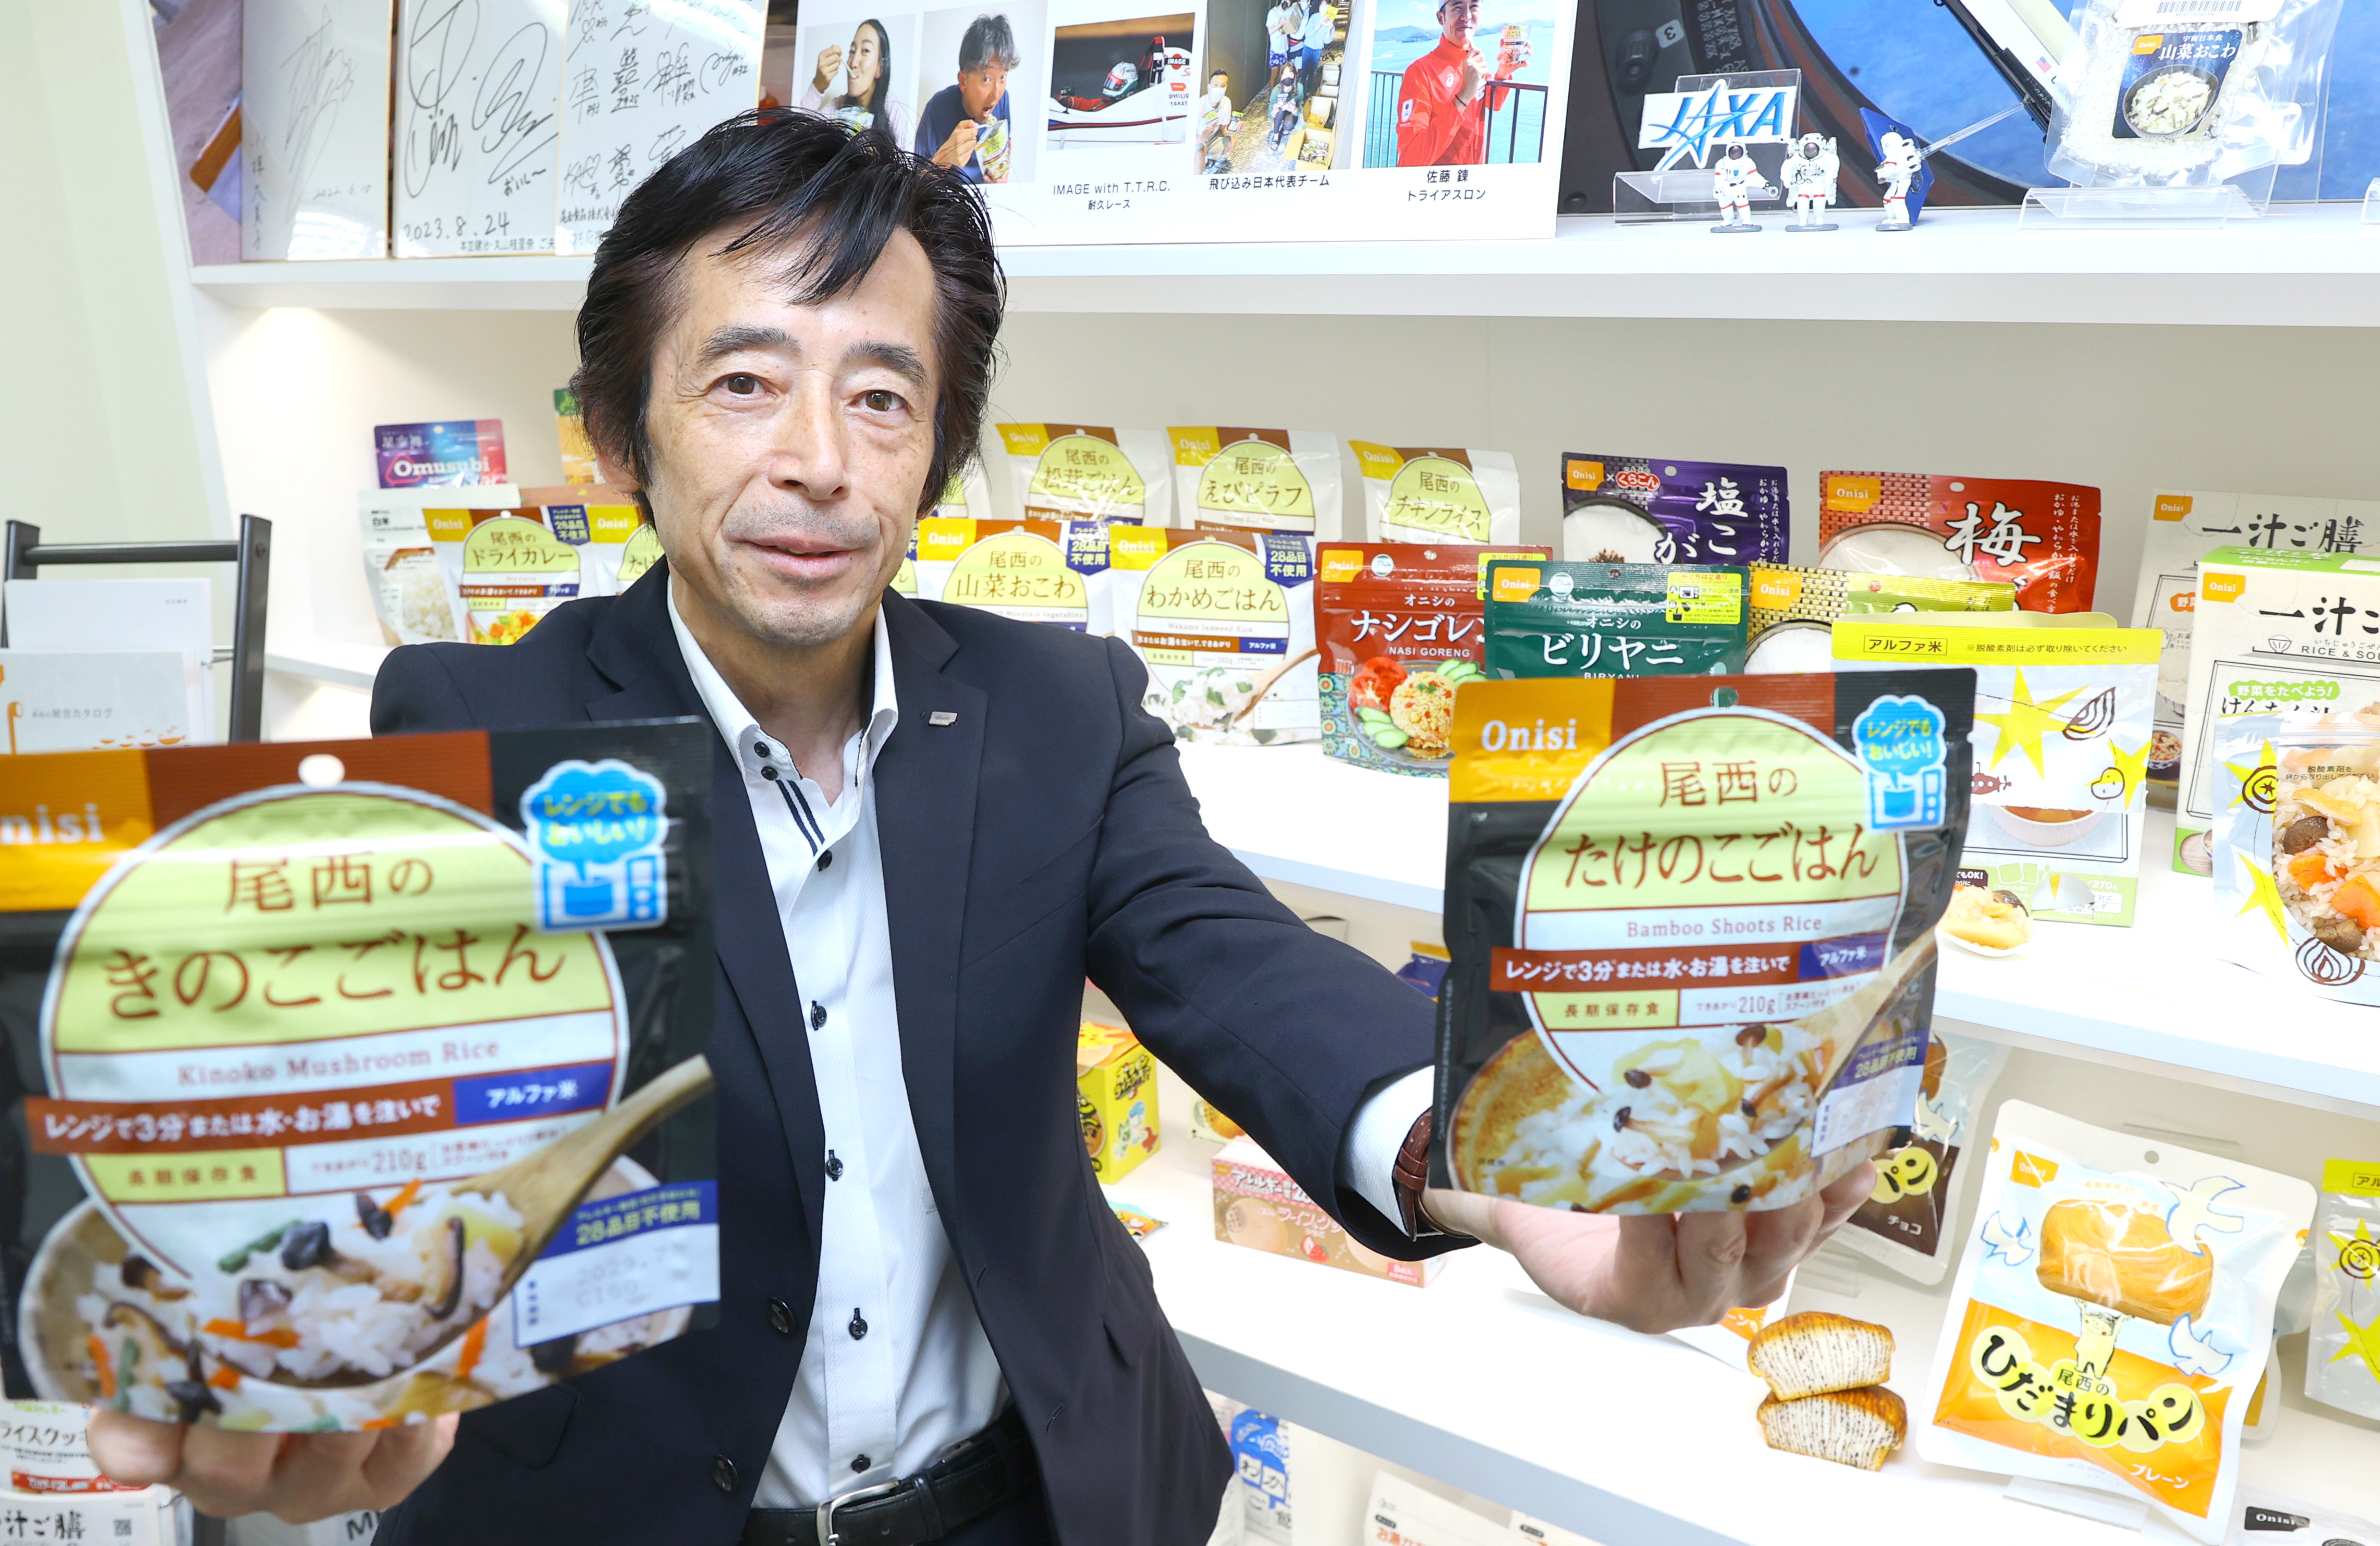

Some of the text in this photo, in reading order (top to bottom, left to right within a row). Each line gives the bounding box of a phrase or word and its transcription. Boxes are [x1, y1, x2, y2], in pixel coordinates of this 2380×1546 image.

[2158, 42, 2236, 60] 山菜おこわ
[1648, 82, 1786, 158] JAXA
[1209, 175, 1330, 191] 飛び込み日本代表チーム
[1427, 170, 1451, 183] 佐藤
[1053, 181, 1171, 196] IMAGE with T.T.R.C.
[1408, 189, 1486, 202] トライアスロン
[1087, 199, 1131, 211] 耐久レース
[1179, 438, 1210, 450] Onisi
[1065, 449, 1110, 466] 尾西の
[1233, 456, 1276, 475] 尾西の
[1363, 451, 1395, 463] Onisi
[393, 456, 490, 477] Omusubi
[1573, 470, 1596, 480] Onisi
[1419, 471, 1460, 493] 尾西の
[1616, 473, 1660, 490] くらこん
[1204, 479, 1303, 508] えびピラフ
[1836, 488, 1869, 499] Onisi
[1394, 495, 1482, 531] チキンライス
[433, 518, 463, 530] Onisi
[597, 517, 628, 529] Onisi
[490, 531, 537, 545] 尾西の
[560, 530, 588, 540] 不使用
[928, 532, 963, 546] Onisi
[1944, 500, 2041, 567] 梅
[2201, 513, 2365, 554] 一汁ご膳
[1071, 540, 1107, 553] 28品目
[1118, 539, 1155, 553] Onisi
[472, 547, 573, 567] ドライカレー
[989, 551, 1043, 569] 尾西の
[1070, 553, 1106, 566] 不使用
[1270, 551, 1307, 563] 28品目
[1328, 561, 1354, 571] Onisi
[1184, 559, 1241, 579] 尾西の
[1269, 564, 1307, 577] 不使用
[956, 573, 1076, 599] 山菜おこわ
[1501, 579, 1530, 589] Onisi
[1760, 583, 1790, 597] Onisi
[2210, 582, 2236, 592] Onisi
[1147, 585, 1281, 612] わかめごはん
[1404, 594, 1455, 607] オニシの
[1237, 625, 1253, 633] Rice
[1585, 616, 1642, 630] オニシの
[1248, 641, 1277, 650] アルファ米
[1389, 646, 1470, 658] NASI GORENG
[1542, 632, 1684, 671] ビリヤニ
[1868, 638, 1942, 653] アルファ米
[1967, 643, 2127, 653] ※脱酸素剤は必ず取り除いてください
[2302, 645, 2338, 657] RICE
[2237, 685, 2334, 699] 野菜をたべよう!
[1481, 718, 1577, 752] Onisi
[1867, 719, 1932, 738] レンジでも
[1869, 741, 1932, 760] おいしい!
[1660, 760, 1798, 808] 尾西の
[544, 791, 647, 816] レンジでも
[548, 816, 647, 846] おいしい!
[1565, 821, 1879, 889] たけのこごはん
[224, 851, 434, 916] 尾西の
[1627, 915, 1822, 938] Bamboo Shoots Rice
[1819, 945, 1867, 968] アルファ米
[103, 924, 565, 1020] きのこごはん
[1565, 1002, 1659, 1018] 長期保存食
[1738, 995, 1776, 1015] 210g
[178, 1041, 499, 1086] Kinoko Mushroom Rice
[486, 1079, 579, 1108] アルファ米
[372, 1148, 426, 1174] 210g
[127, 1165, 258, 1186] 長期保存食
[577, 1199, 701, 1246] 28品目不使用
[1887, 1214, 1923, 1236] チョコ
[1981, 1334, 2194, 1441] ひだまりパン
[2057, 1368, 2110, 1397] 尾西の
[2130, 1463, 2190, 1490] プレーン
[0, 1510, 84, 1540] 汁ご膳
